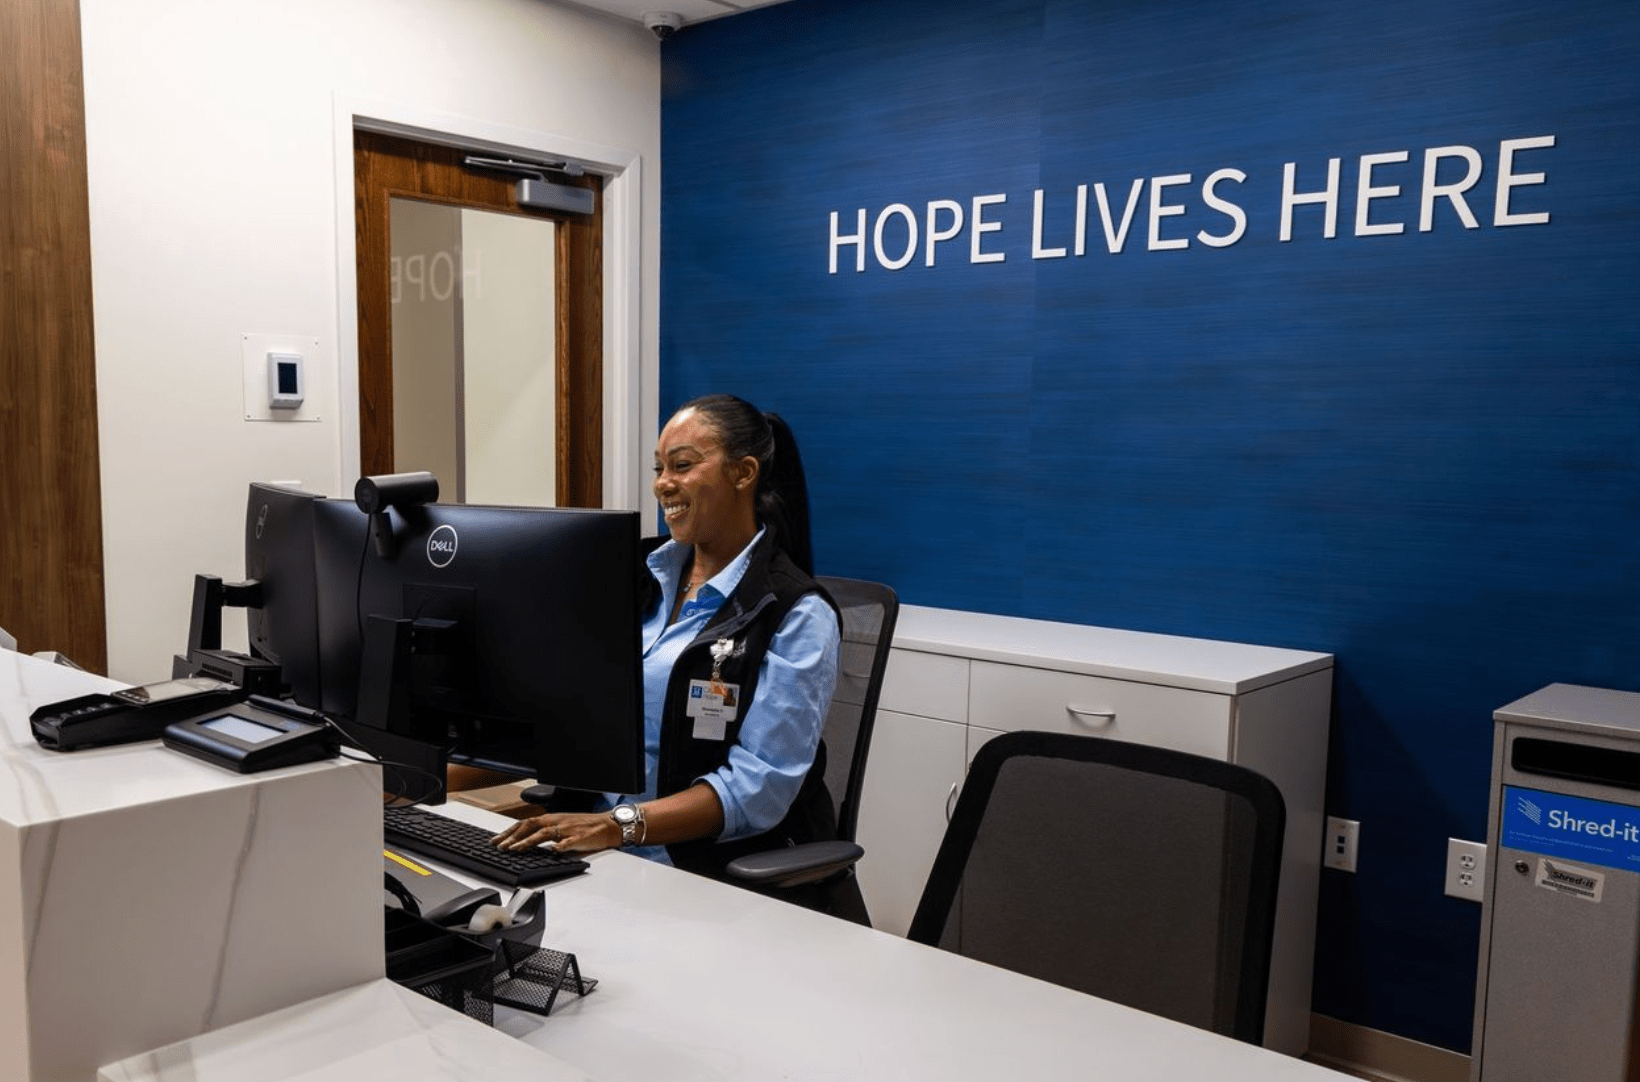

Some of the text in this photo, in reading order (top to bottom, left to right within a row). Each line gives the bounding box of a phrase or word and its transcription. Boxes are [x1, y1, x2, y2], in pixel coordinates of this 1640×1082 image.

[829, 135, 1556, 274] HOPE LIVES HERE
[430, 539, 454, 553] DELL
[1547, 809, 1640, 843] Shred-it
